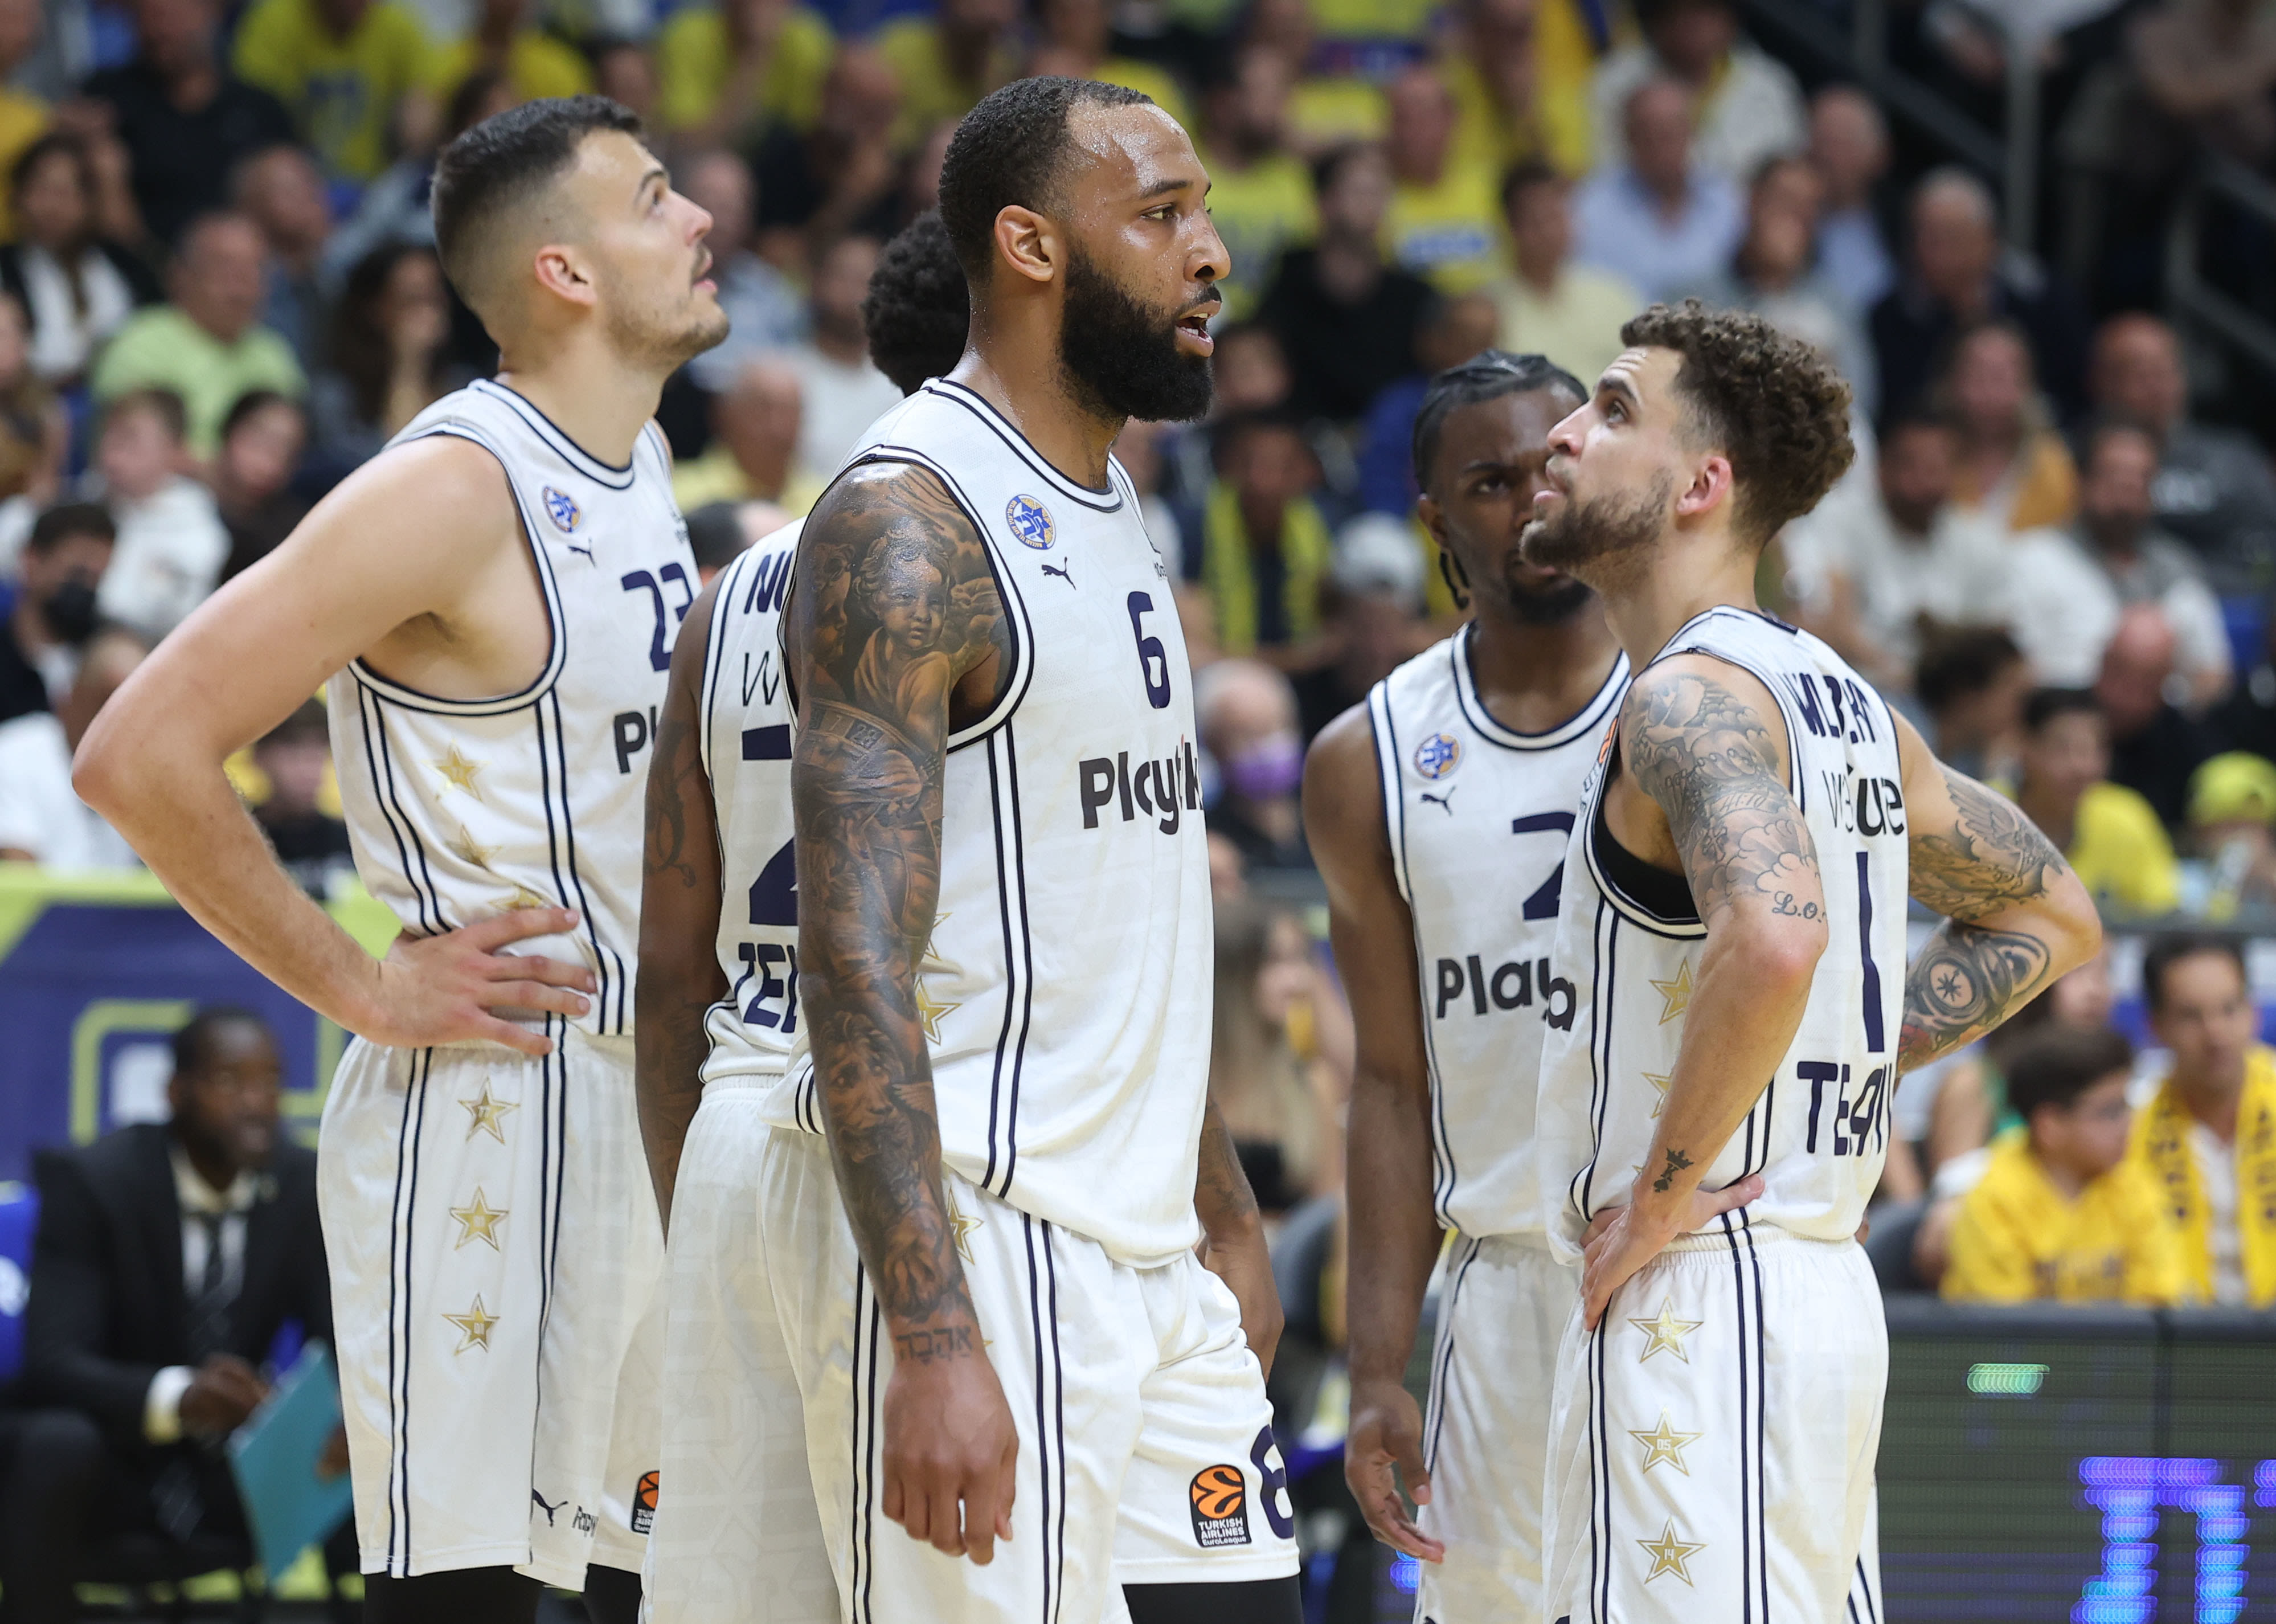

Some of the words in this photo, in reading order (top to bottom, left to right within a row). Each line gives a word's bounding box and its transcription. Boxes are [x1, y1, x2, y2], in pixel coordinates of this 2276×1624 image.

[1128, 591, 1170, 709] 6
[1856, 852, 1884, 1052] 1
[1656, 1438, 1672, 1451] 05
[1198, 1516, 1243, 1531] TURKISH
[1201, 1527, 1245, 1540] AIRLINES
[1202, 1536, 1247, 1546] EuroLeague
[1664, 1548, 1674, 1561] 14
